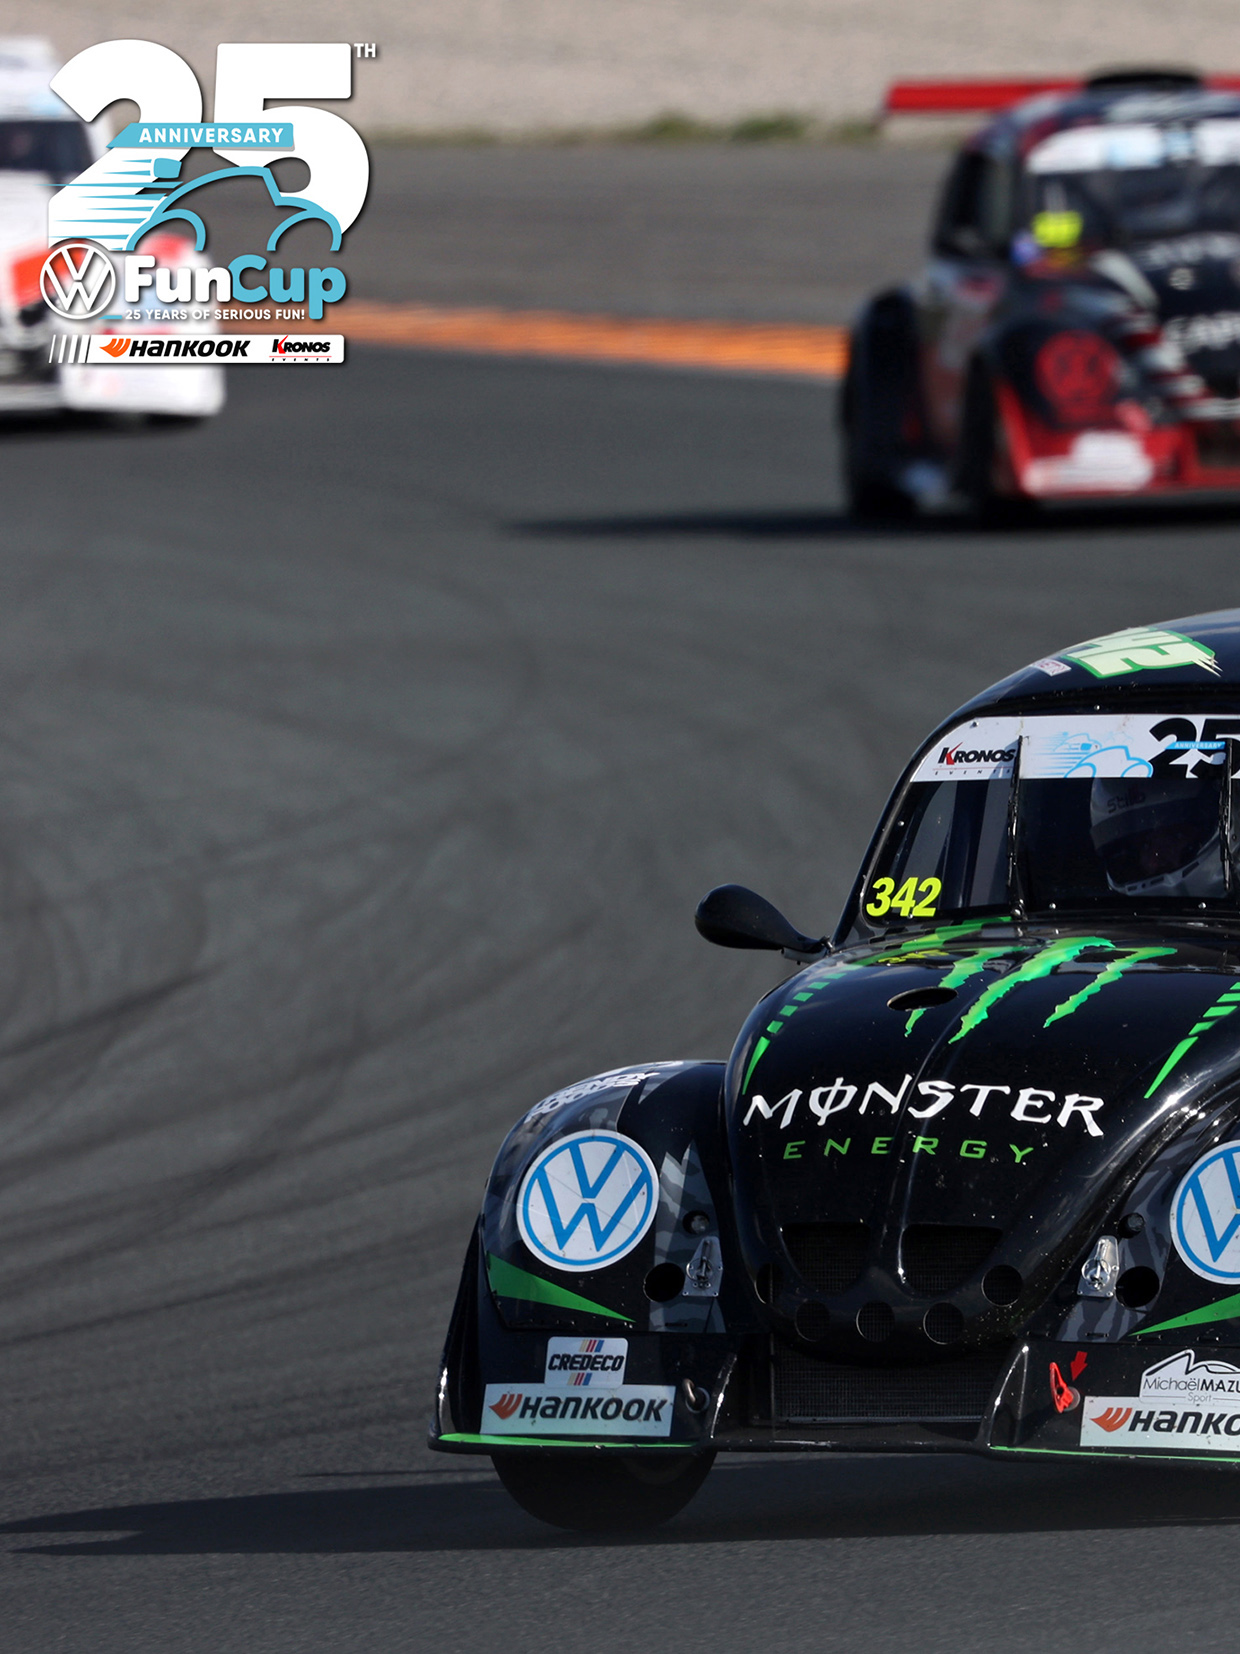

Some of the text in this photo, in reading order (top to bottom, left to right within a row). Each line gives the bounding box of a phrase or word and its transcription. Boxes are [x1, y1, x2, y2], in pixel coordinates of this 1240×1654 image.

[938, 742, 1016, 765] KRONOS
[866, 876, 942, 917] 342
[783, 1135, 1034, 1164] ENERGY
[548, 1353, 625, 1371] CREDECO
[1187, 1392, 1212, 1403] Sport
